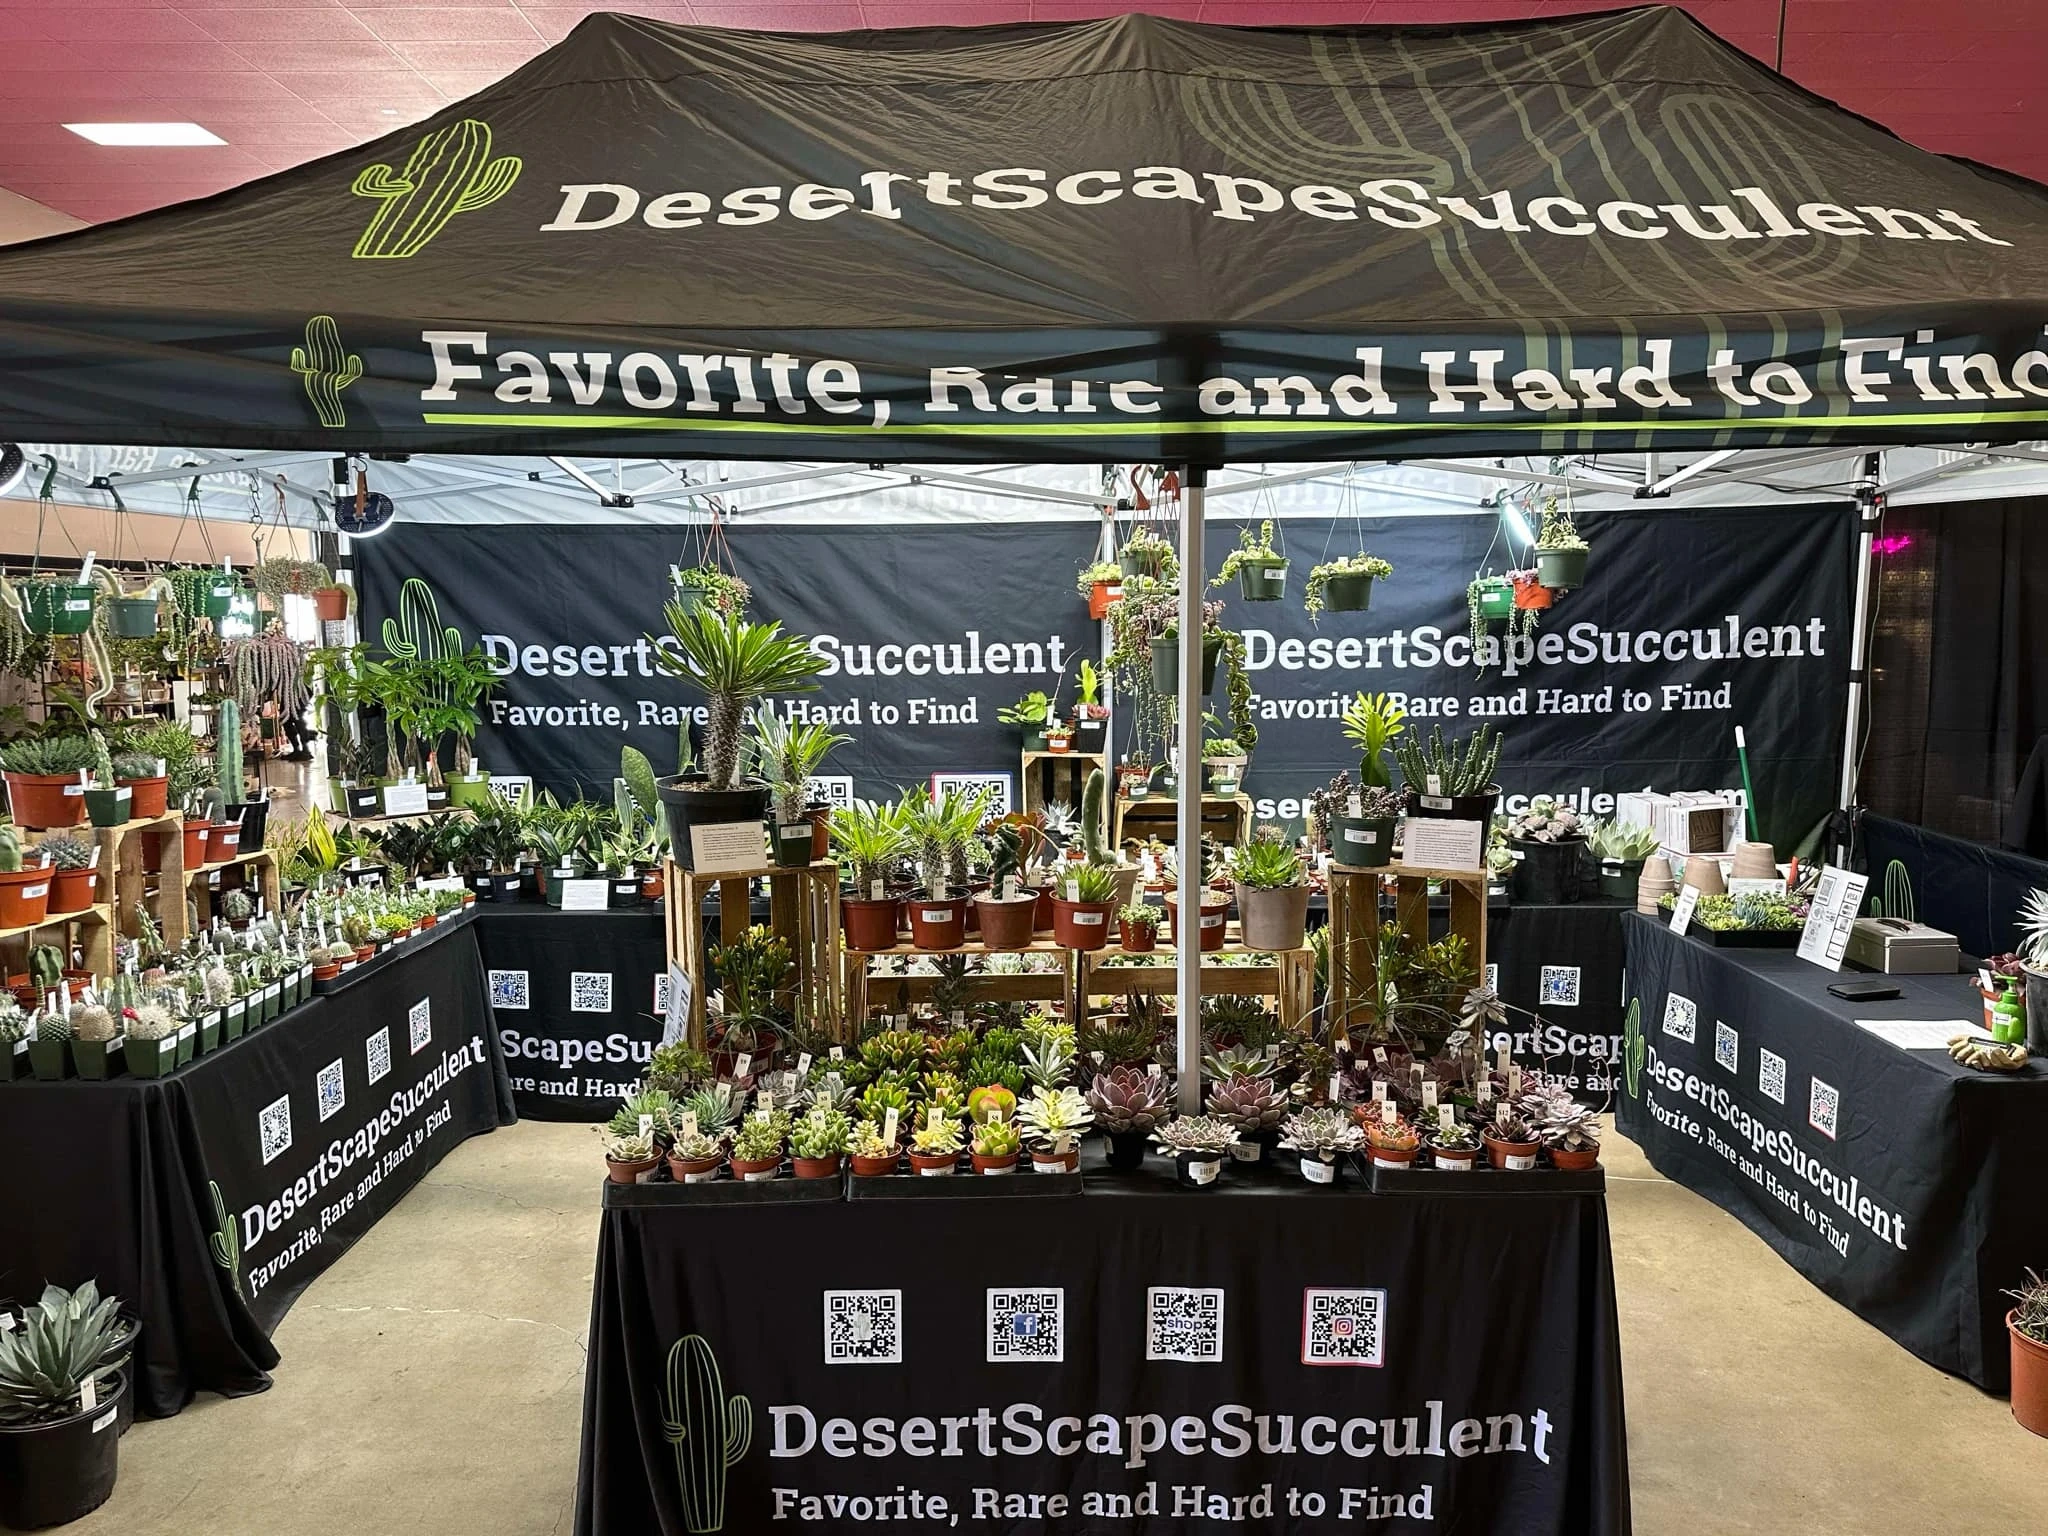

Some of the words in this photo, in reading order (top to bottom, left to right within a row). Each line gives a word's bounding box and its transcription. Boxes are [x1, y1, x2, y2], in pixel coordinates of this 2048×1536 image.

[540, 165, 2014, 247] DesertScapeSucculent
[420, 330, 891, 429] Favorite,
[1198, 347, 1398, 416] and
[1420, 338, 1692, 413] Hard
[1707, 348, 1813, 406] to
[481, 630, 1066, 677] DesertSSucculent
[1240, 614, 1826, 677] DesertScapeSucculent
[489, 699, 629, 731] Favorite,
[637, 699, 709, 726] Rare
[872, 700, 900, 725] to
[907, 697, 979, 725] Find
[1468, 687, 1528, 717] and
[1535, 685, 1613, 715] Hard
[1622, 689, 1652, 712] to
[1660, 681, 1732, 712] Find
[539, 1076, 578, 1097] and
[585, 1078, 641, 1097] Hard
[241, 1035, 486, 1252] DesertScapeSucculent
[1646, 1045, 1908, 1251] DesertScapeSucculent
[249, 1226, 322, 1298] Favorite,
[320, 1189, 355, 1233] Rare
[357, 1163, 382, 1199] and
[382, 1136, 414, 1178] Hard
[426, 1099, 452, 1138] Find
[1706, 1126, 1737, 1165] Rare
[1739, 1155, 1764, 1187] and
[1765, 1170, 1800, 1215] Hard
[1803, 1200, 1816, 1227] to
[1818, 1211, 1850, 1258] Find
[1167, 1316, 1204, 1332] shop
[768, 1400, 1553, 1470] DesertScapeSucculent
[771, 1486, 958, 1528] Favorite,
[971, 1487, 1069, 1519] Rare
[1081, 1482, 1159, 1518] and
[1171, 1484, 1275, 1521] Hard
[1286, 1487, 1327, 1517] to
[1338, 1485, 1435, 1520] Find
